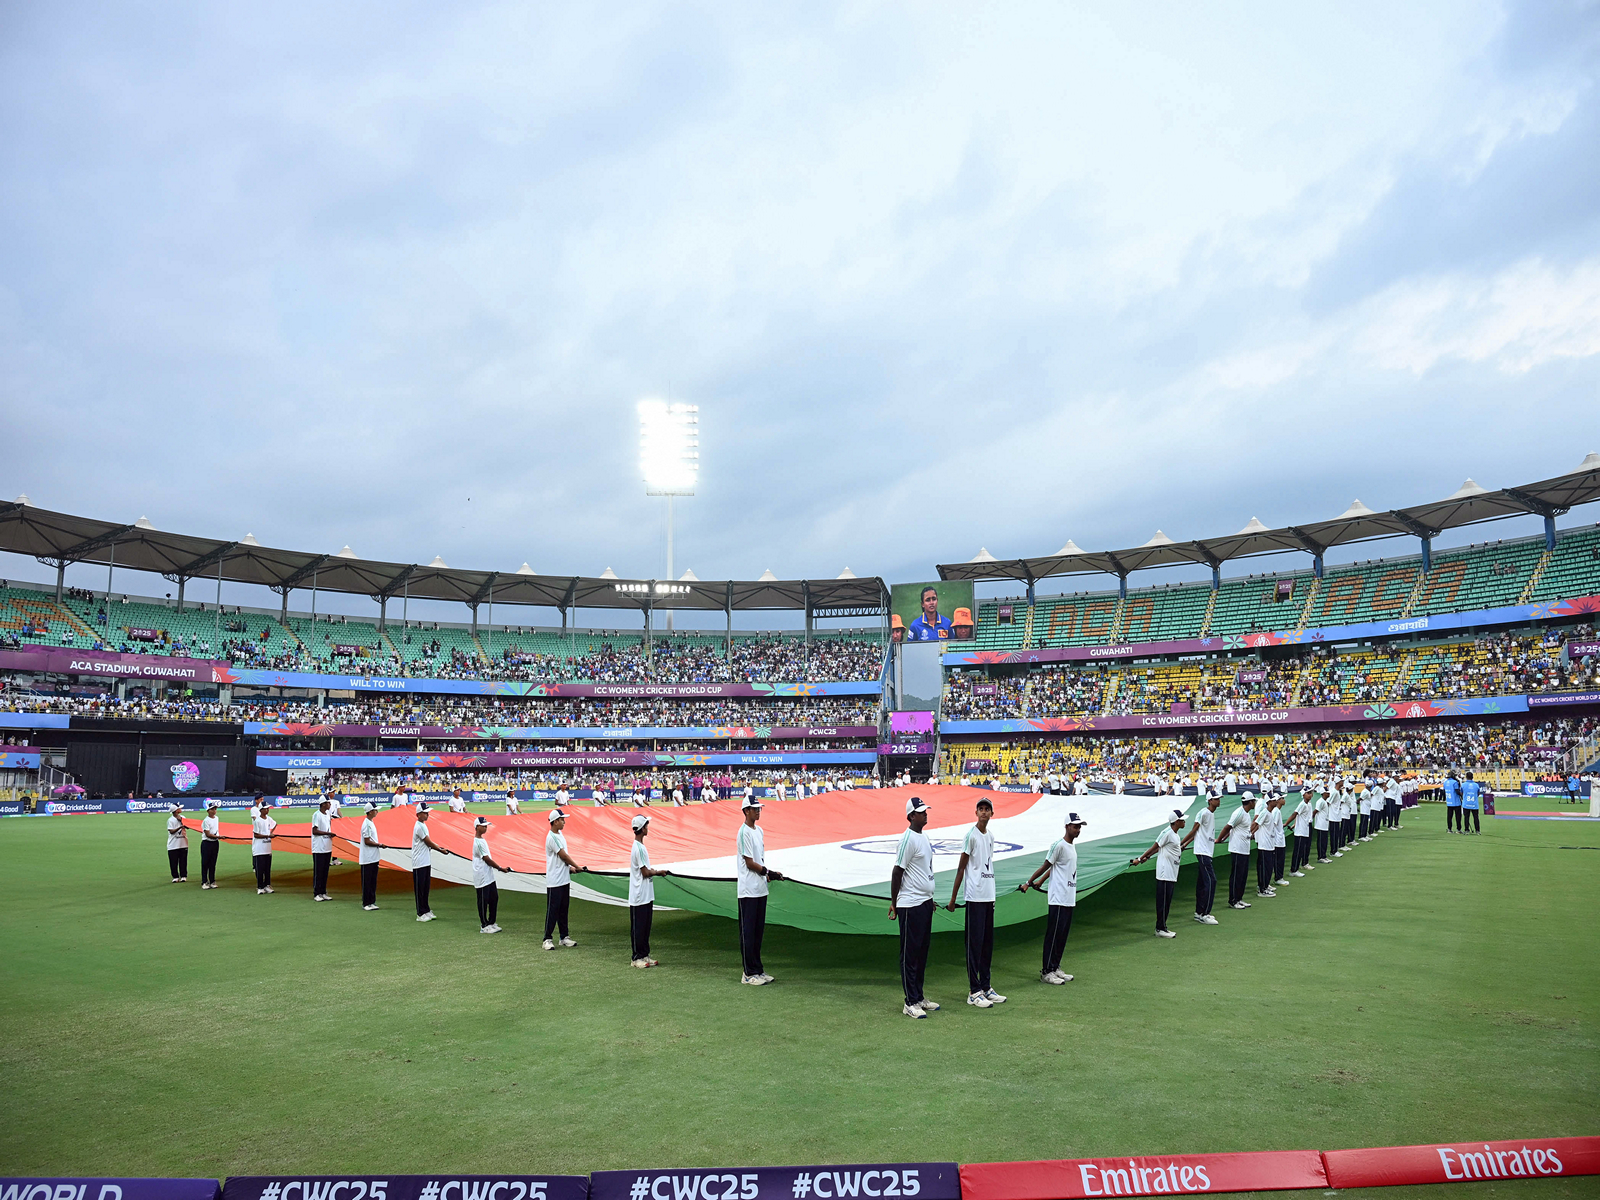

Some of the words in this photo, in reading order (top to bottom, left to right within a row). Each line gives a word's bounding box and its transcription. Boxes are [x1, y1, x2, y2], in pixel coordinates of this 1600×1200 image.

[1090, 646, 1132, 656] GUWAHATI
[70, 660, 92, 671] ACA
[94, 663, 142, 676] STADIUM,
[143, 666, 196, 678] GUWAHATI
[350, 678, 371, 688] WILL
[373, 680, 386, 688] TO
[1158, 716, 1198, 724] WOMEN'S
[1199, 714, 1235, 723] CRICKET
[1236, 713, 1269, 722] WORLD
[1270, 712, 1289, 720] CUP
[1436, 1144, 1564, 1180] Emirates
[630, 1174, 760, 1200] #CWC25
[792, 1170, 921, 1198] #CWC25
[1078, 1161, 1211, 1196] Emirates
[258, 1181, 388, 1200] #CWC25
[418, 1180, 548, 1200] #CWC25
